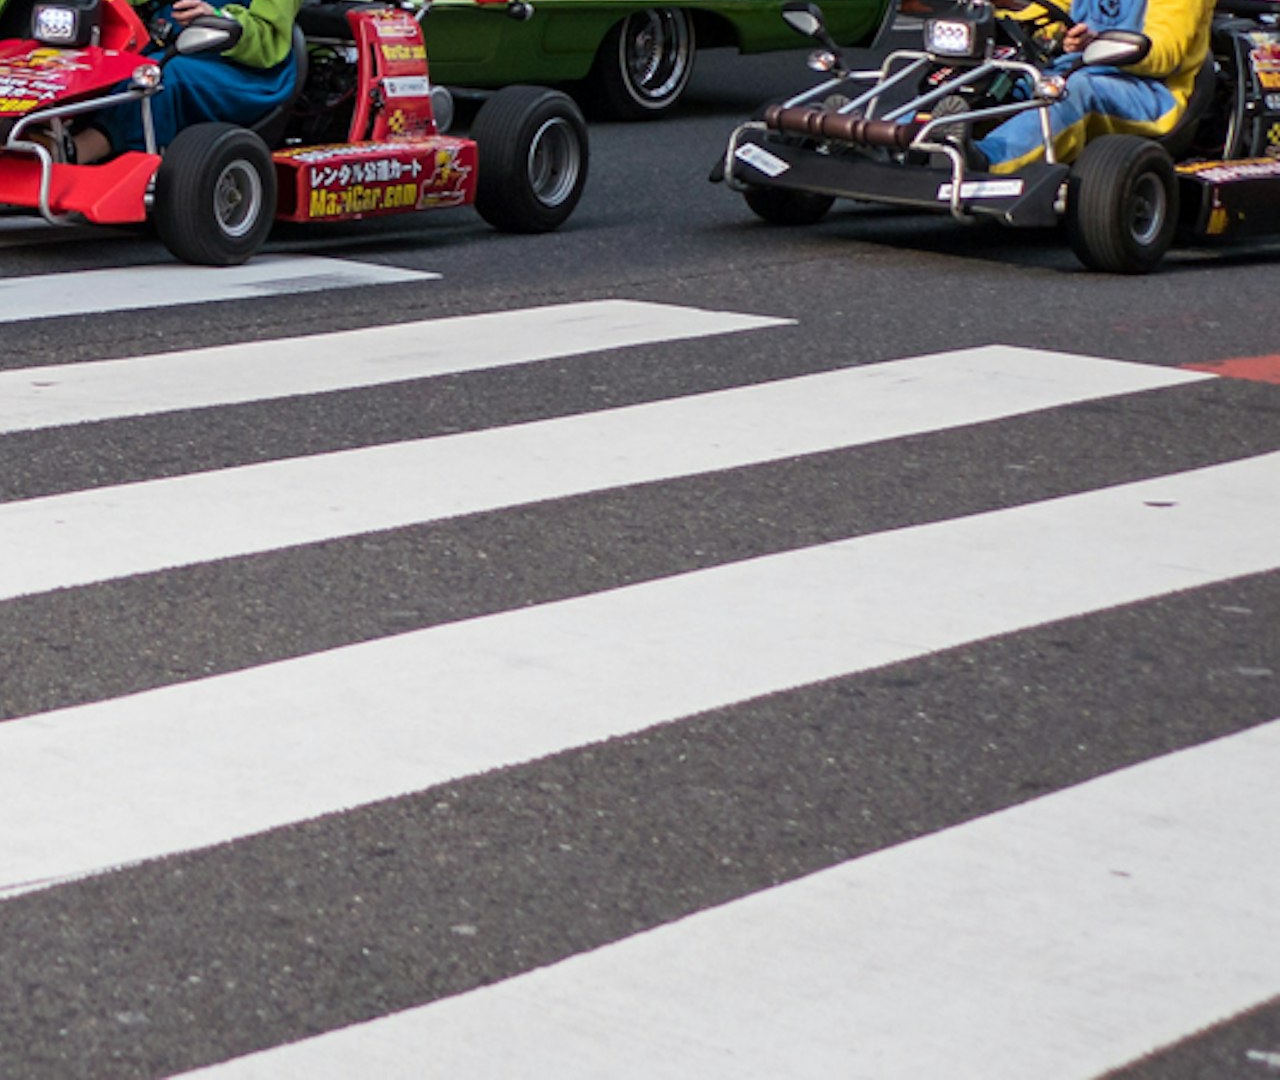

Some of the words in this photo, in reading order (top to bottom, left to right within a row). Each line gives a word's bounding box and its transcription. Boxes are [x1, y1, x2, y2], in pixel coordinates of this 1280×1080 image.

[310, 158, 422, 188] レンタル公道カート
[309, 184, 417, 218] MariCar.com
